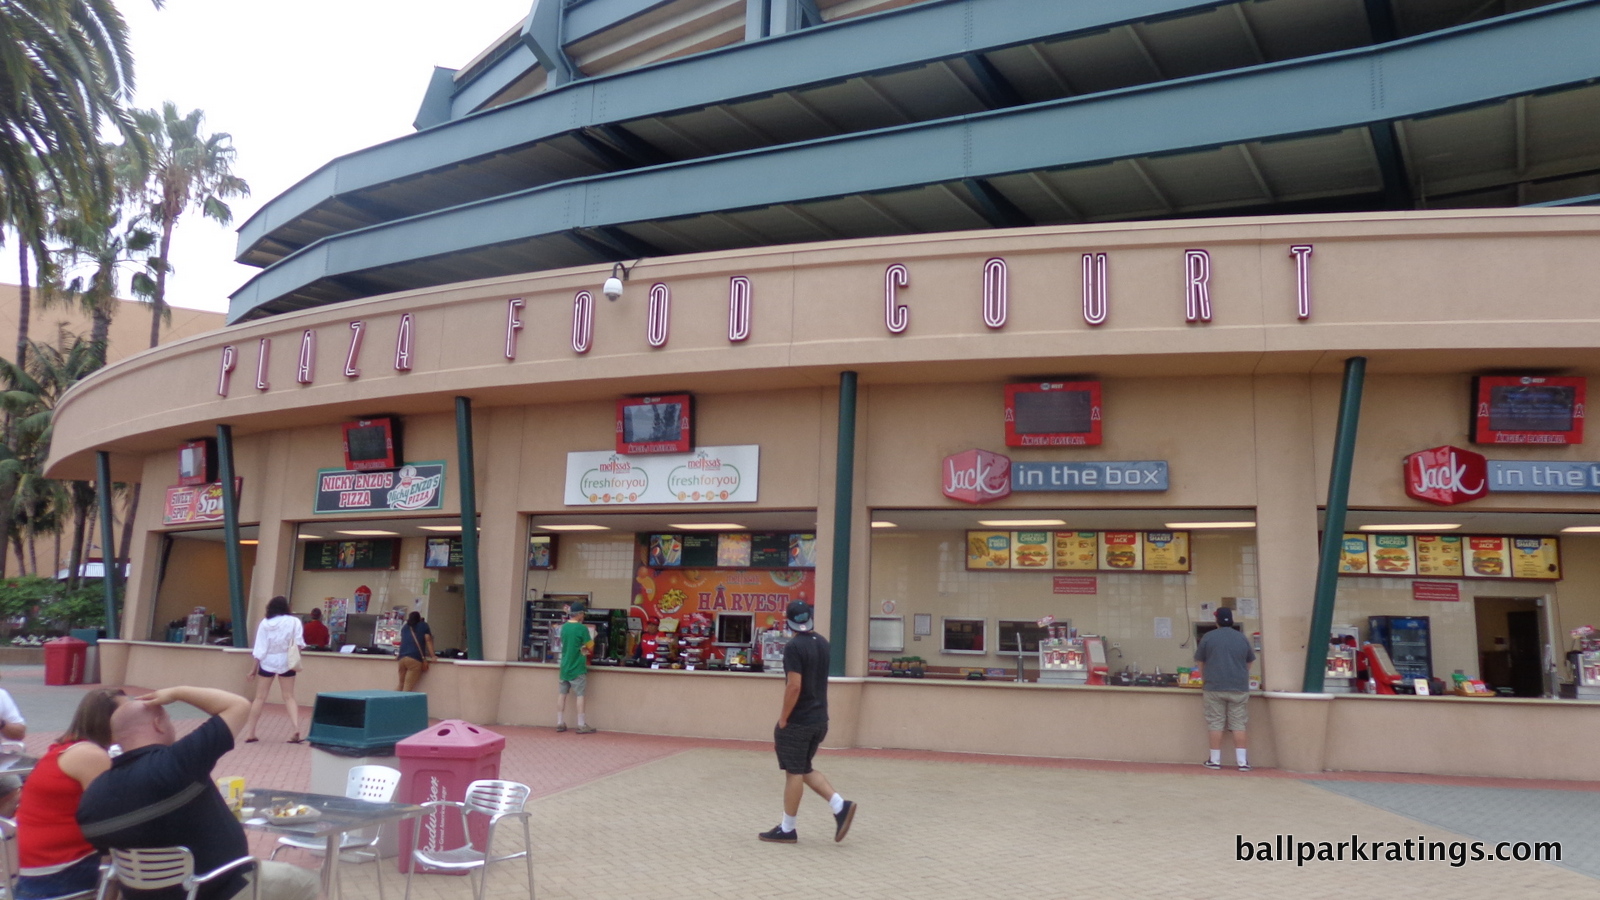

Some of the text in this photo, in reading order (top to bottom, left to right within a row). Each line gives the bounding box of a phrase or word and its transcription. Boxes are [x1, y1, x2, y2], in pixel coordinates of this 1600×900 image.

[218, 244, 1313, 397] PLAZA FOOD COURT
[322, 472, 393, 491] NICKY ENZO'S
[945, 455, 1160, 494] Jack in the box
[1414, 452, 1485, 494] Jack
[1497, 465, 1525, 485] in
[1532, 465, 1586, 486] the
[171, 491, 193, 505] SWEET
[339, 491, 371, 507] PIZZA
[388, 476, 440, 505] Nicky ENZO'S
[407, 490, 430, 505] PIZZA
[172, 505, 189, 520] SPOT
[697, 583, 790, 612] HARVEST
